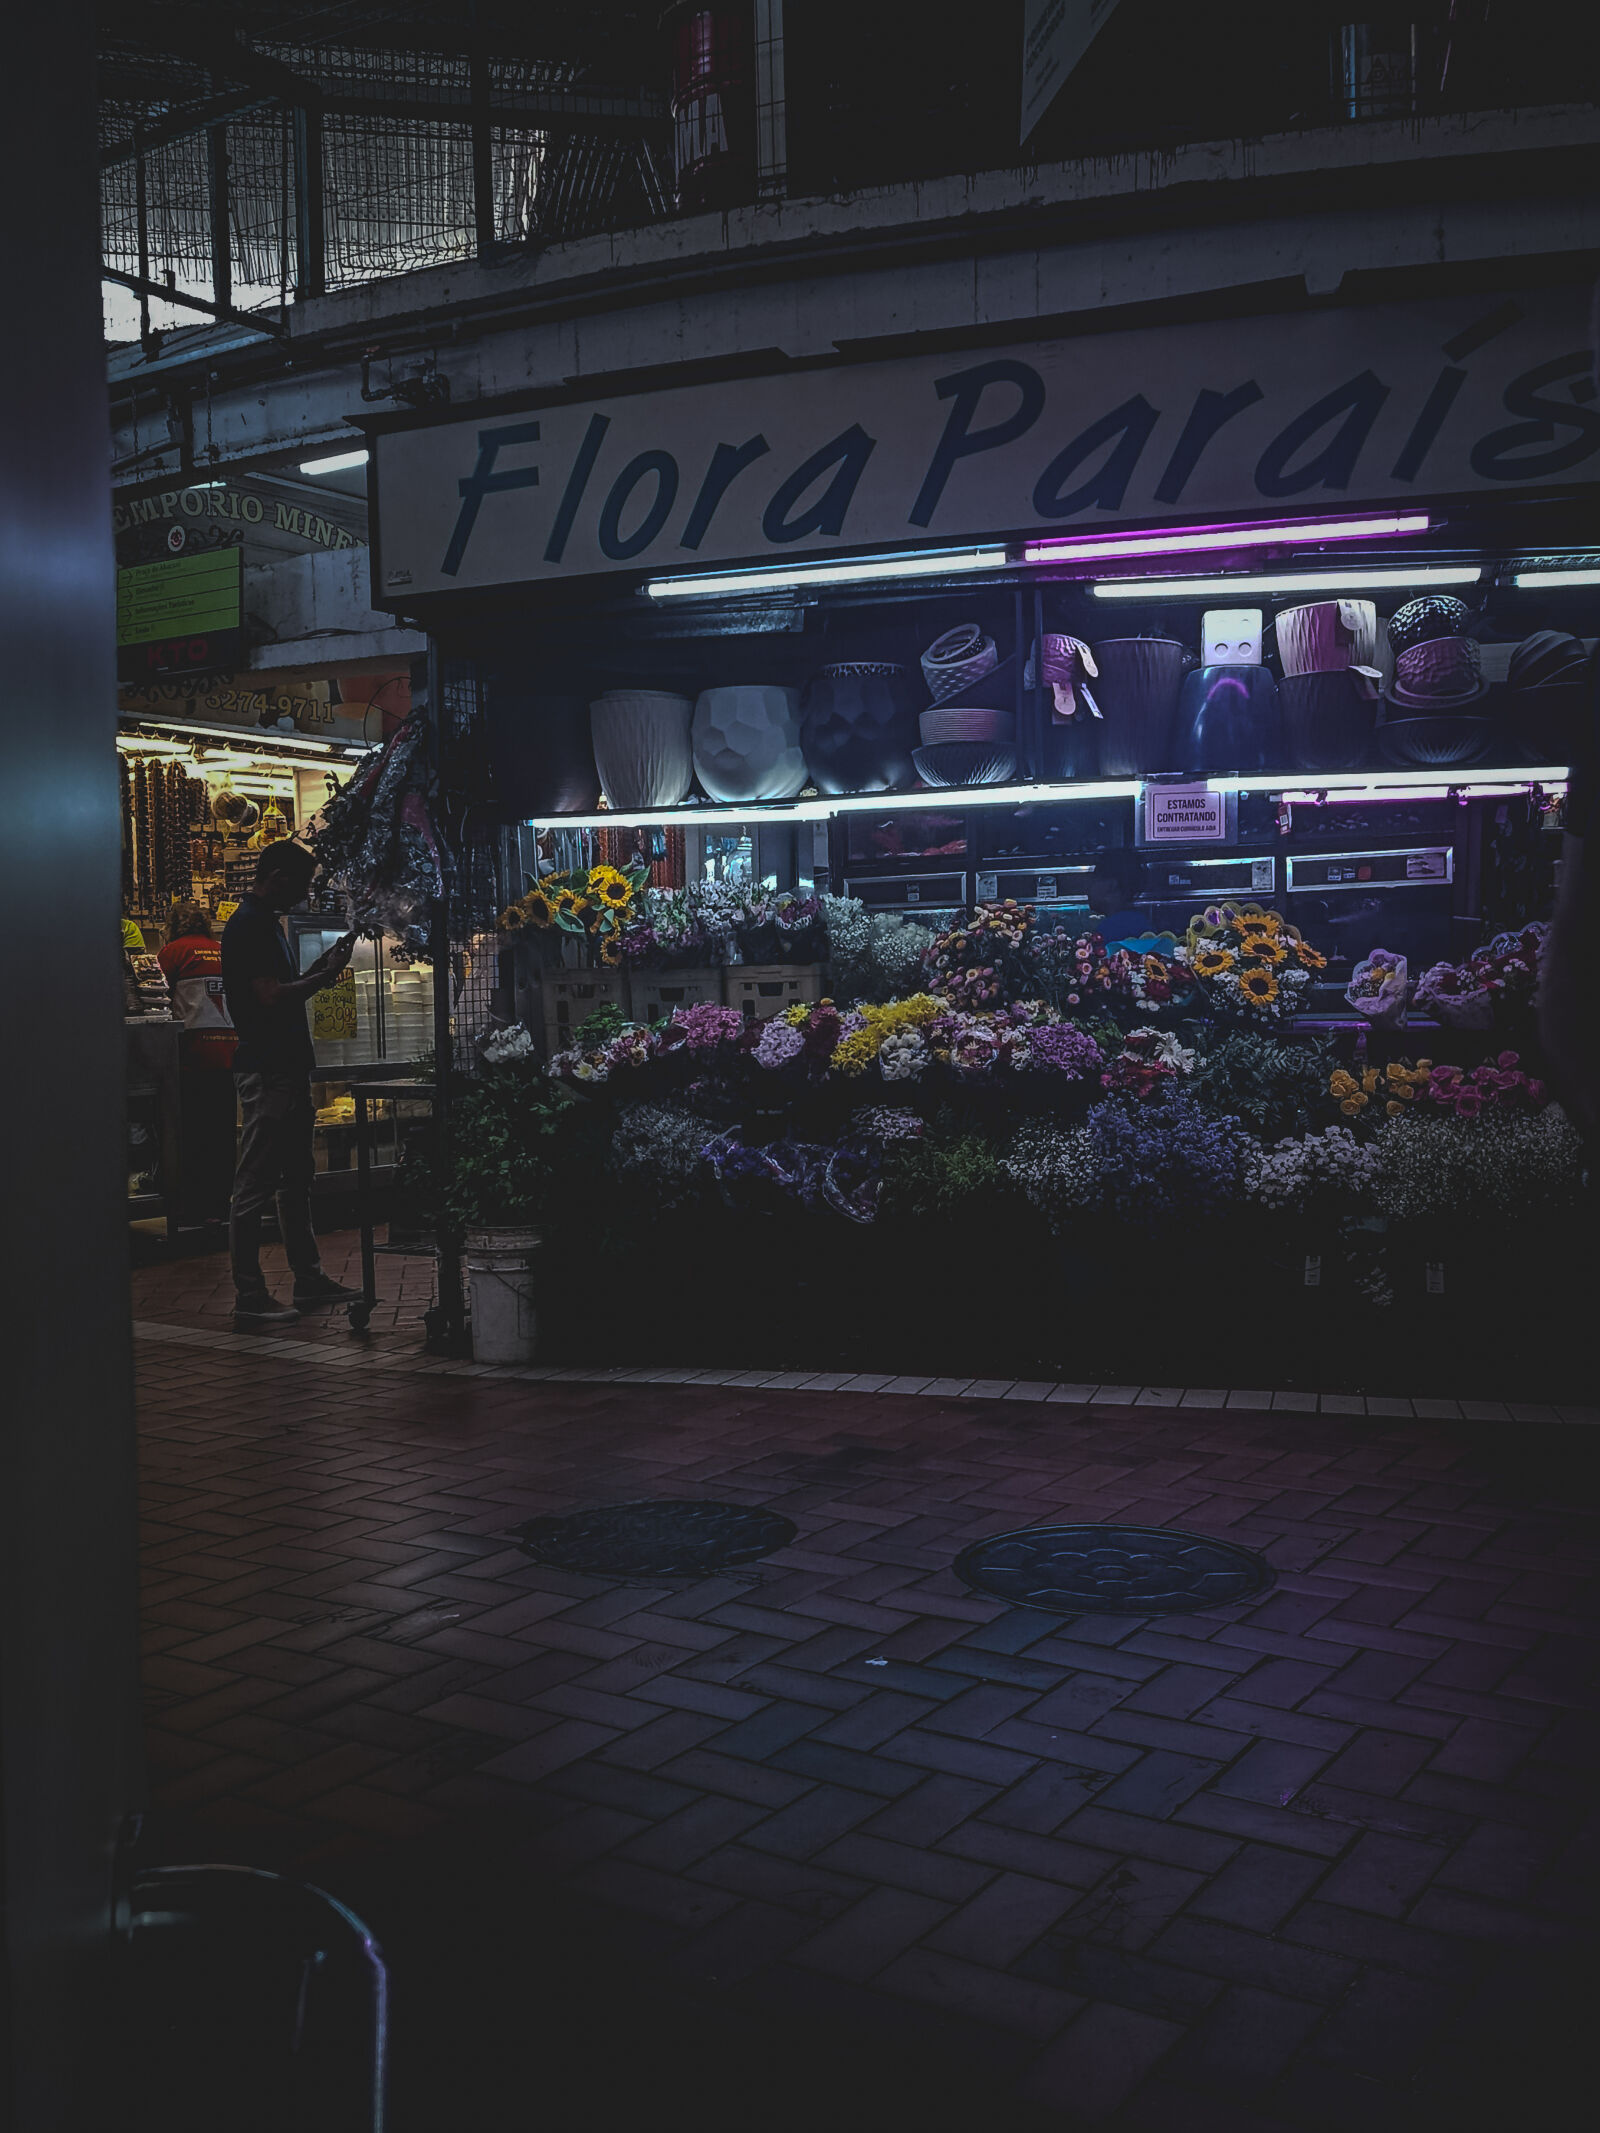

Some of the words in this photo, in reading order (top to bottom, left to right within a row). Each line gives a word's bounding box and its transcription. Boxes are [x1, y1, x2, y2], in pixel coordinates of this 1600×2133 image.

[441, 412, 877, 577] Flora
[146, 638, 209, 669] KTO
[1168, 799, 1205, 810] ESTAMOS
[1157, 811, 1216, 823] CONTRATANDO
